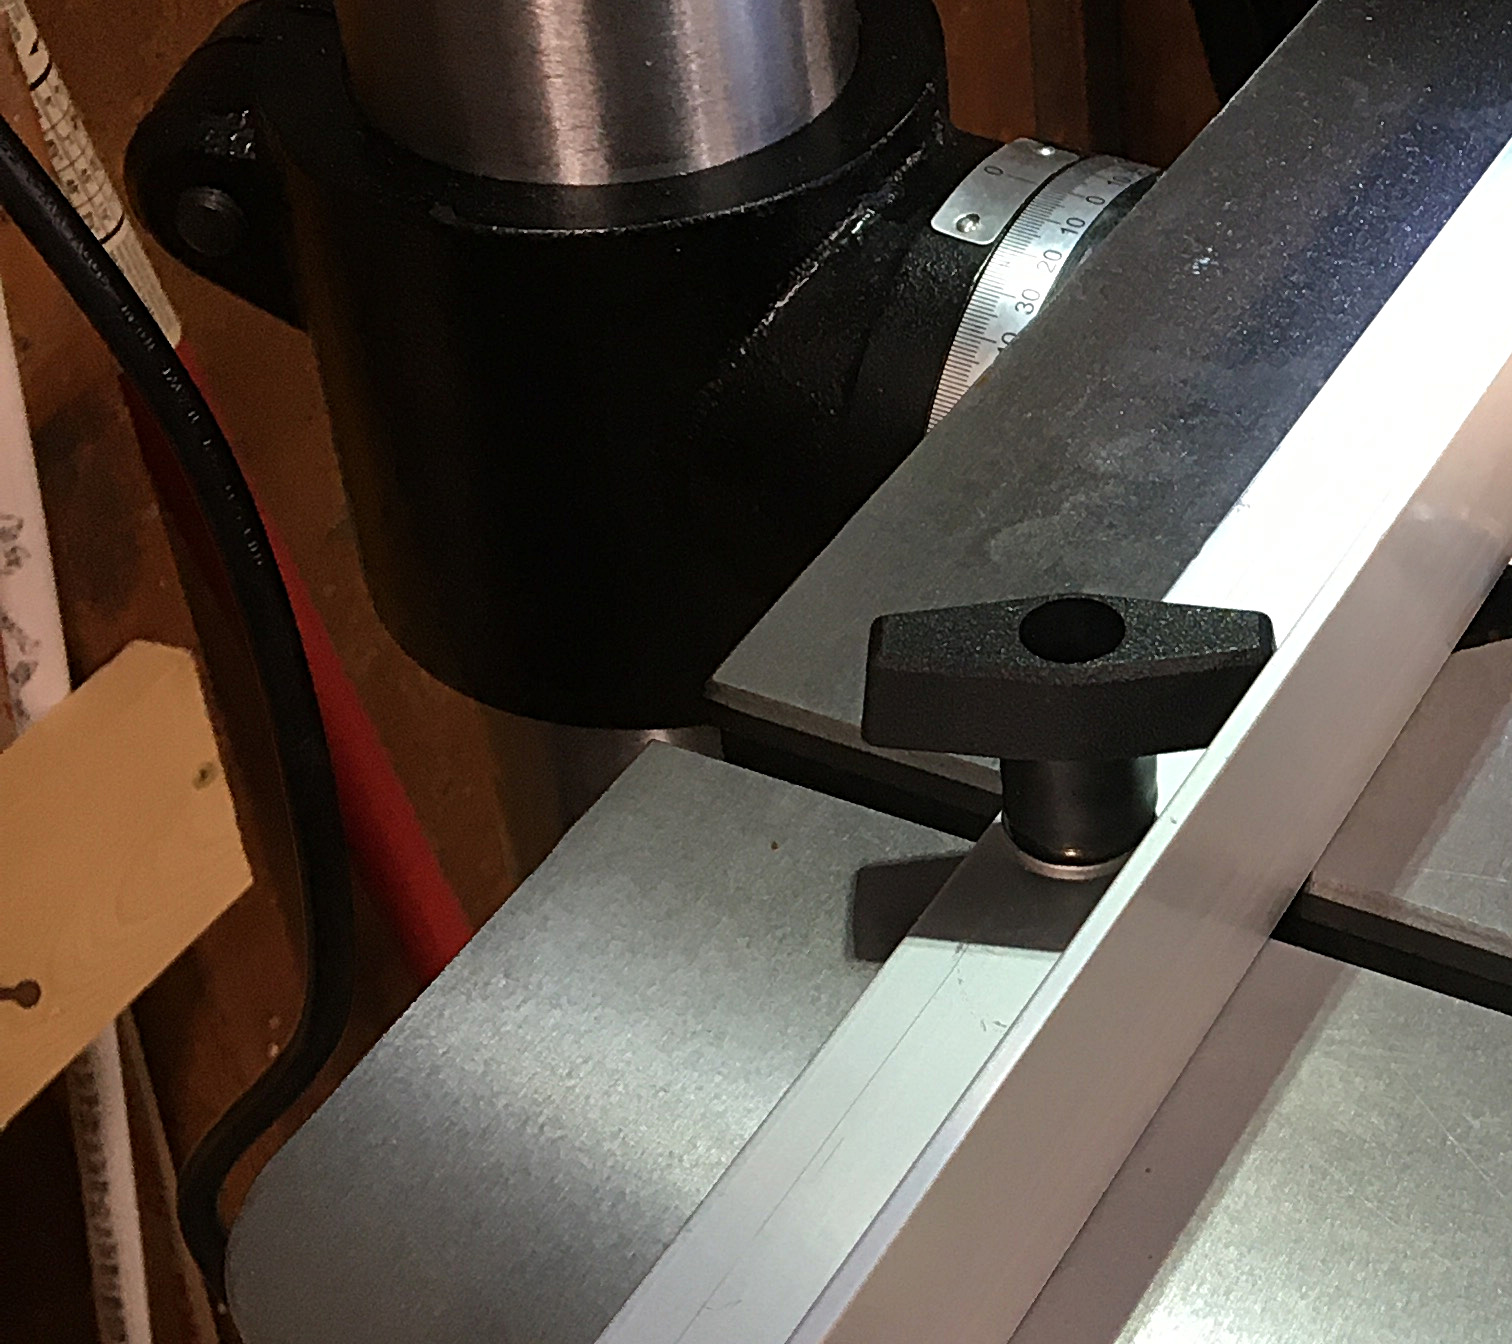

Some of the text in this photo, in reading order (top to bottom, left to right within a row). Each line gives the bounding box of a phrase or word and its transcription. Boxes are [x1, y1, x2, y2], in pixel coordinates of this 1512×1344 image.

[984, 164, 1004, 176] 0
[1085, 195, 1106, 206] 0
[1060, 217, 1086, 235] 10
[1036, 248, 1063, 274] 20
[1014, 288, 1041, 316] 30
